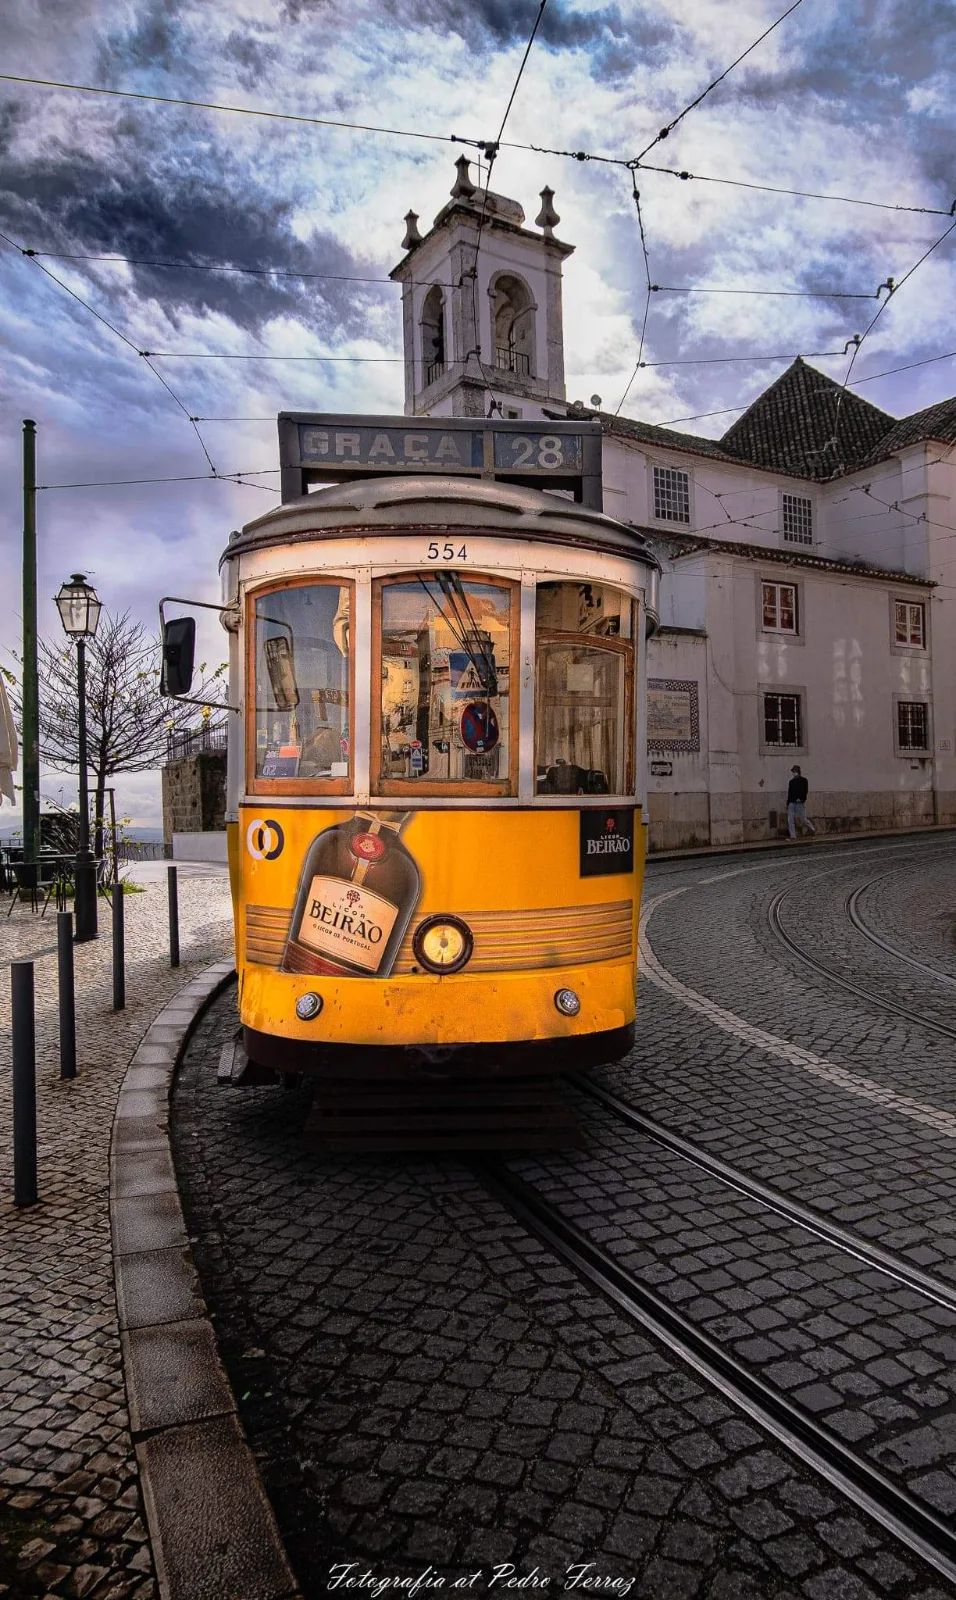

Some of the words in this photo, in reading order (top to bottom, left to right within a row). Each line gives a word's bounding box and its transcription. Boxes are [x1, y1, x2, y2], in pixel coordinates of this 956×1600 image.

[304, 431, 462, 462] GRAÇA
[511, 434, 564, 468] 28
[427, 542, 468, 561] 554
[587, 837, 630, 854] BEIRÃO
[308, 898, 383, 944] BEIRÃO
[332, 902, 366, 920] LICOR
[317, 925, 333, 935] LICOR
[342, 936, 372, 951] PORTUGAL
